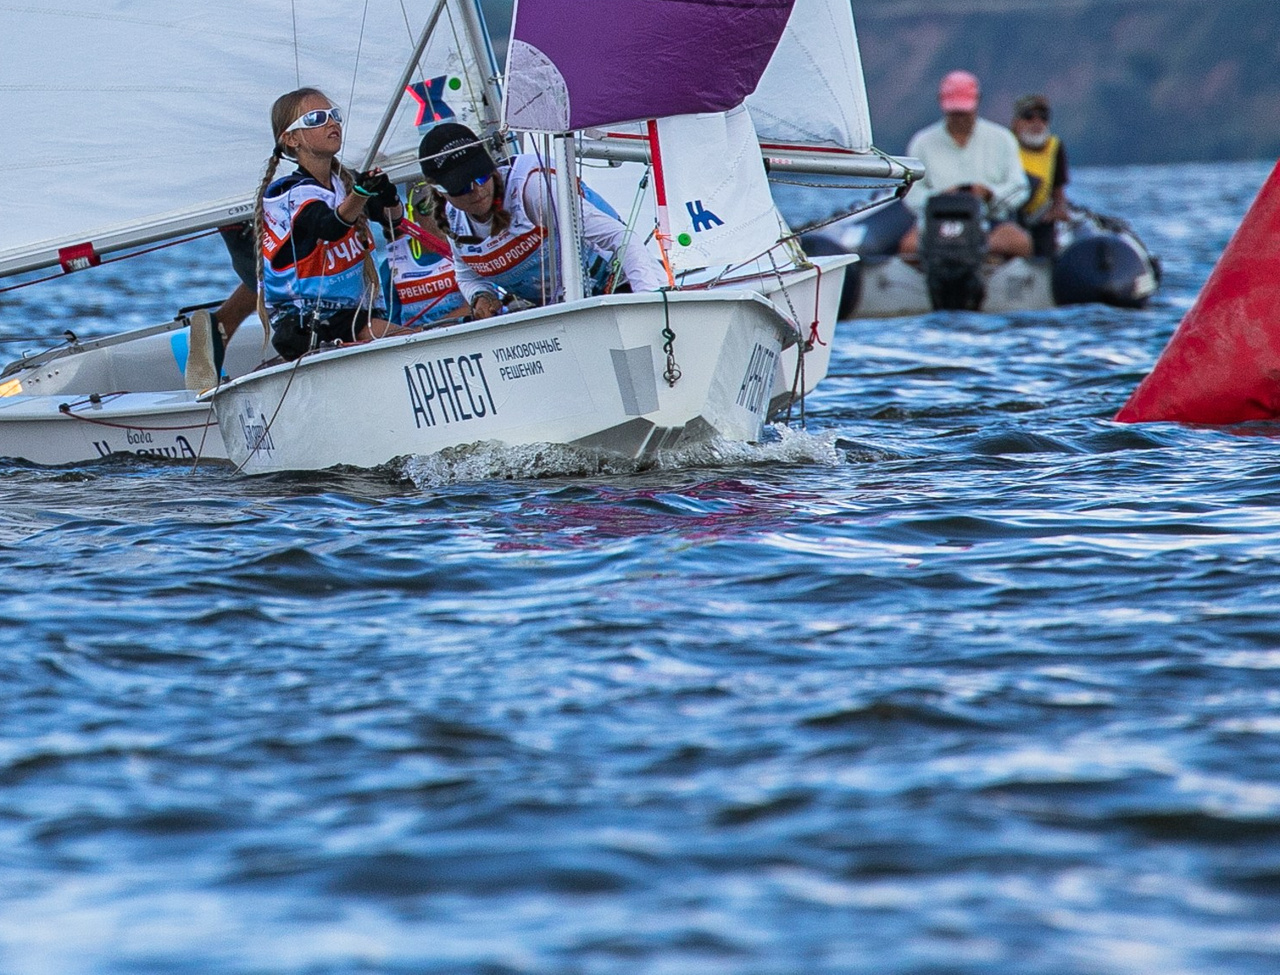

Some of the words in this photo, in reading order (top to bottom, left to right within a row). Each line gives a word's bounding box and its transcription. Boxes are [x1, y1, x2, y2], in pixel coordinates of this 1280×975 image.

[505, 233, 542, 263] РОССИИ
[492, 337, 562, 363] УПАКОВОЧНЫЕ
[499, 360, 545, 381] РЕШЕНИЯ
[404, 352, 497, 428] АРНЕСТ
